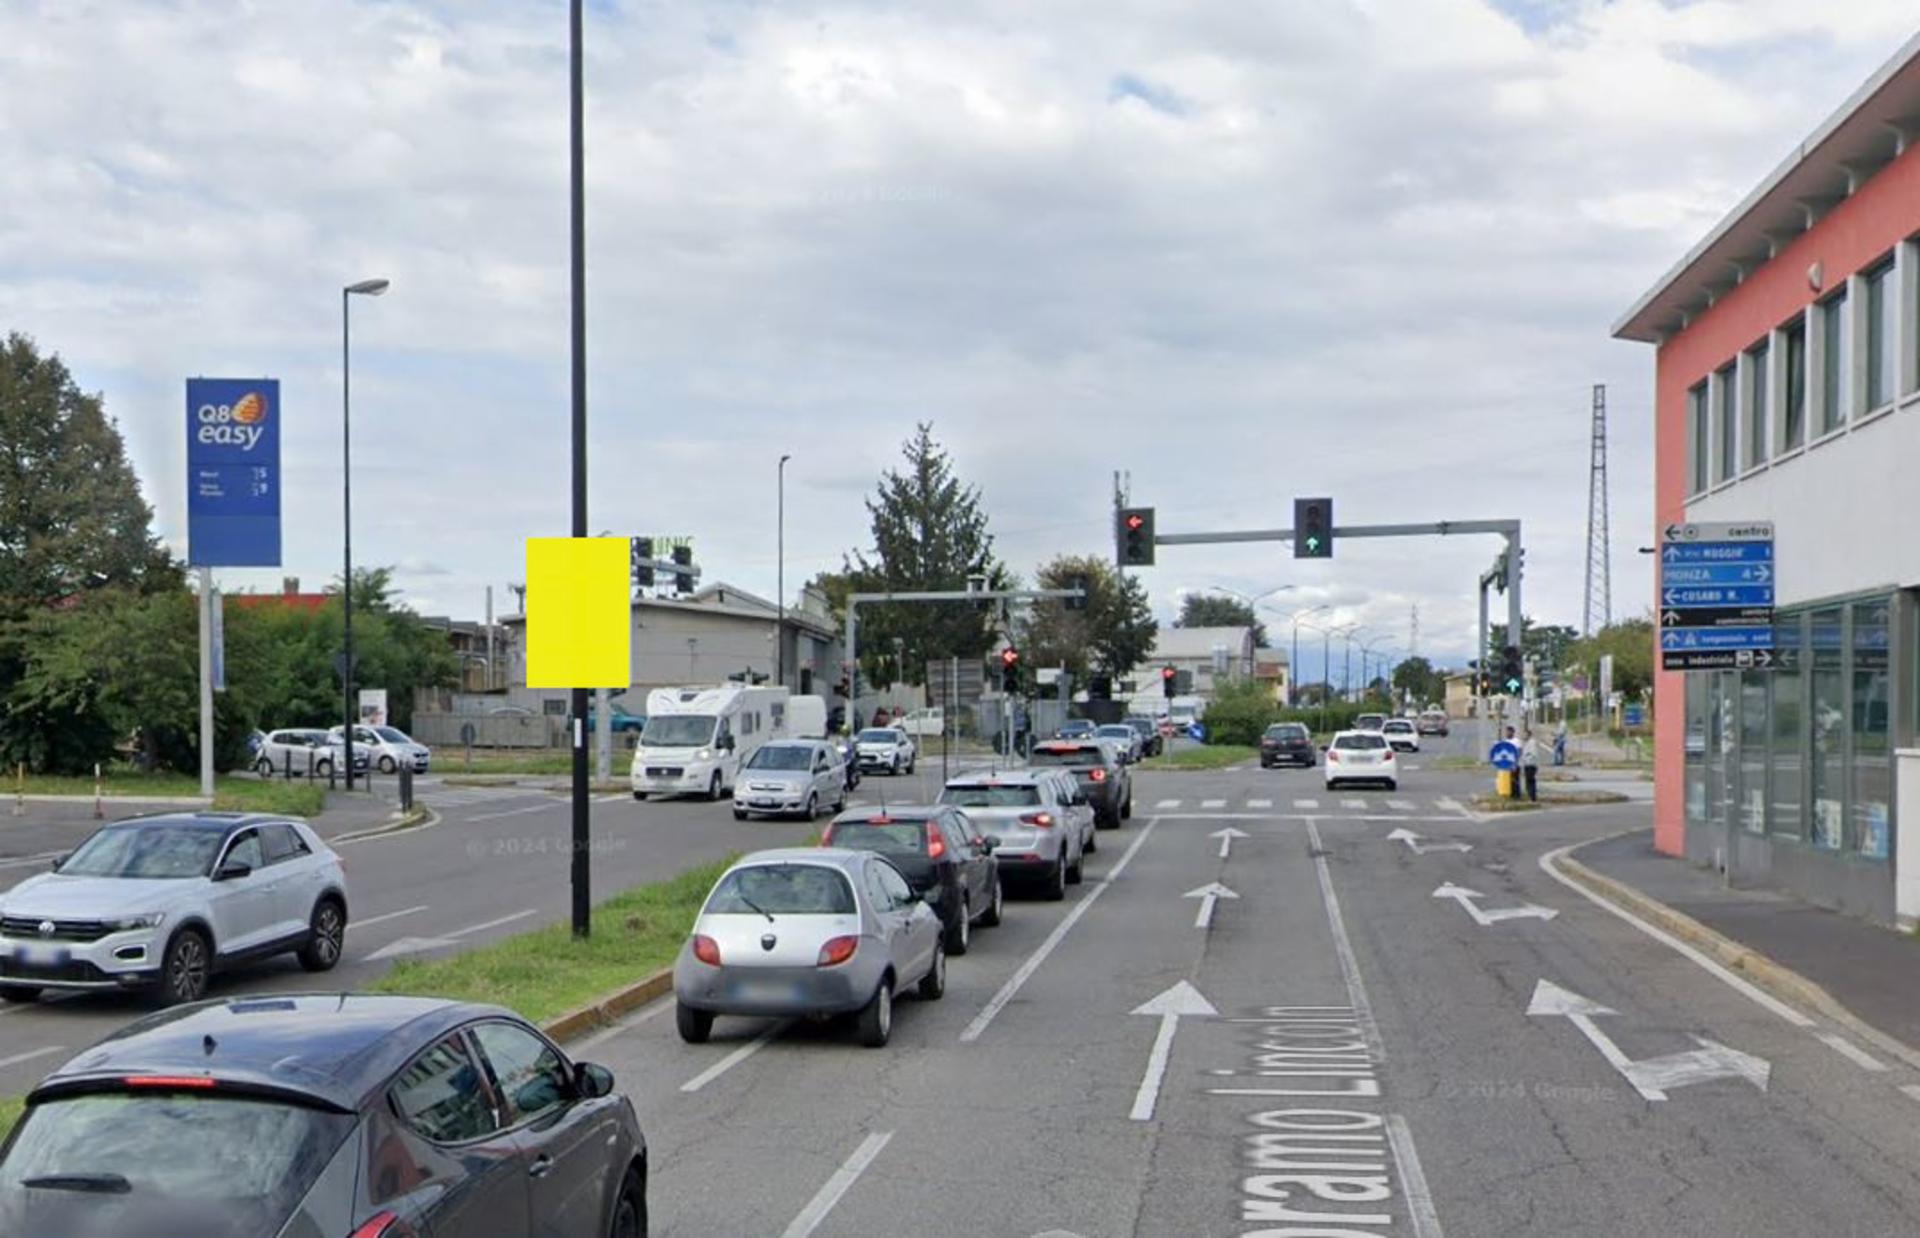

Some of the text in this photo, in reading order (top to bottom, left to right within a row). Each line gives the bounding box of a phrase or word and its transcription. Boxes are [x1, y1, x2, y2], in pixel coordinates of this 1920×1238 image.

[198, 404, 230, 423] Q8
[198, 424, 263, 451] easy
[1727, 526, 1770, 537] centro
[1663, 568, 1711, 581] MONZA
